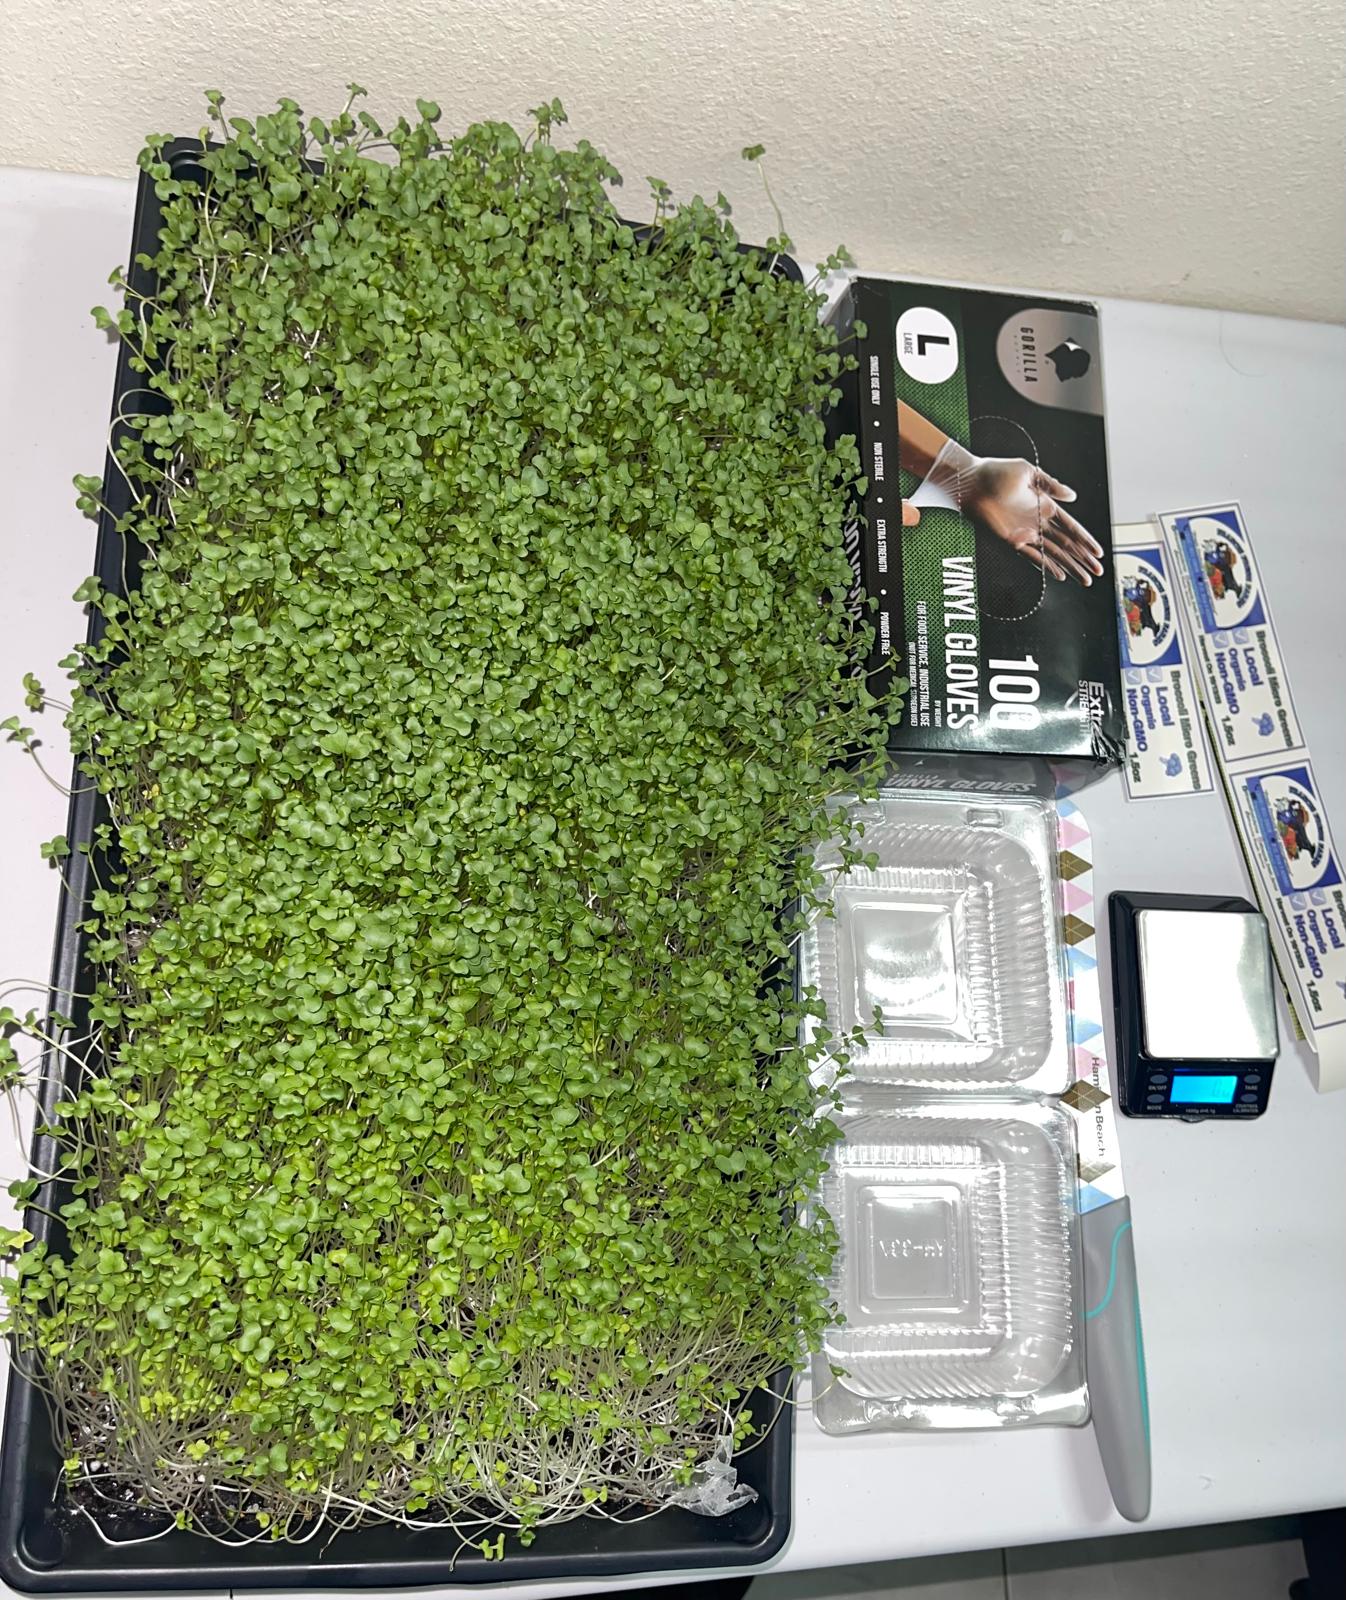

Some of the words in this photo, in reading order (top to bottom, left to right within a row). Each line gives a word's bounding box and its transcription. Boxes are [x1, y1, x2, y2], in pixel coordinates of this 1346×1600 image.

[903, 332, 913, 355] LARGE
[917, 334, 950, 356] L
[1020, 327, 1038, 382] GORILLA
[870, 355, 879, 377] SINGLE
[871, 377, 880, 389] USE
[872, 390, 880, 405] ONLY
[874, 442, 882, 455] NON
[874, 456, 884, 481] STERILE
[877, 519, 886, 540] EXTRA
[878, 540, 888, 573] STRENGTH
[917, 600, 927, 615] FOR
[942, 556, 977, 627] VINYL
[880, 612, 890, 638] POWDER
[918, 615, 928, 634] FOOD
[881, 639, 890, 655] FREE
[909, 655, 917, 665] FOR
[918, 635, 929, 668] SERVICE,
[910, 666, 918, 688] MEDICAL
[945, 632, 979, 729] GLOVES
[1215, 652, 1240, 714] Non-GMO
[1229, 648, 1247, 692] Organic
[1243, 647, 1264, 686] Local
[920, 668, 930, 711] INDUSTRIAL
[989, 654, 1041, 730] 100
[1170, 670, 1189, 716] Broccoli
[1256, 631, 1276, 675] Broccoli
[1268, 676, 1283, 707] Micro
[1278, 709, 1293, 747] Greens
[921, 712, 929, 727] USE
[1127, 689, 1148, 752] Non-GMO
[1141, 685, 1157, 730] Organic
[1156, 686, 1175, 726] Local
[1180, 718, 1193, 748] Micro
[1221, 716, 1236, 746] 1.5oz
[1129, 752, 1143, 783] 1.5oz
[1186, 750, 1201, 790] Greens
[884, 778, 946, 788] VINYL
[949, 780, 1037, 792] GLOVES
[1307, 910, 1328, 954] Organic
[1322, 908, 1346, 949] Local
[1294, 914, 1324, 979] Non-GMO
[1095, 1115, 1106, 1157] Beach
